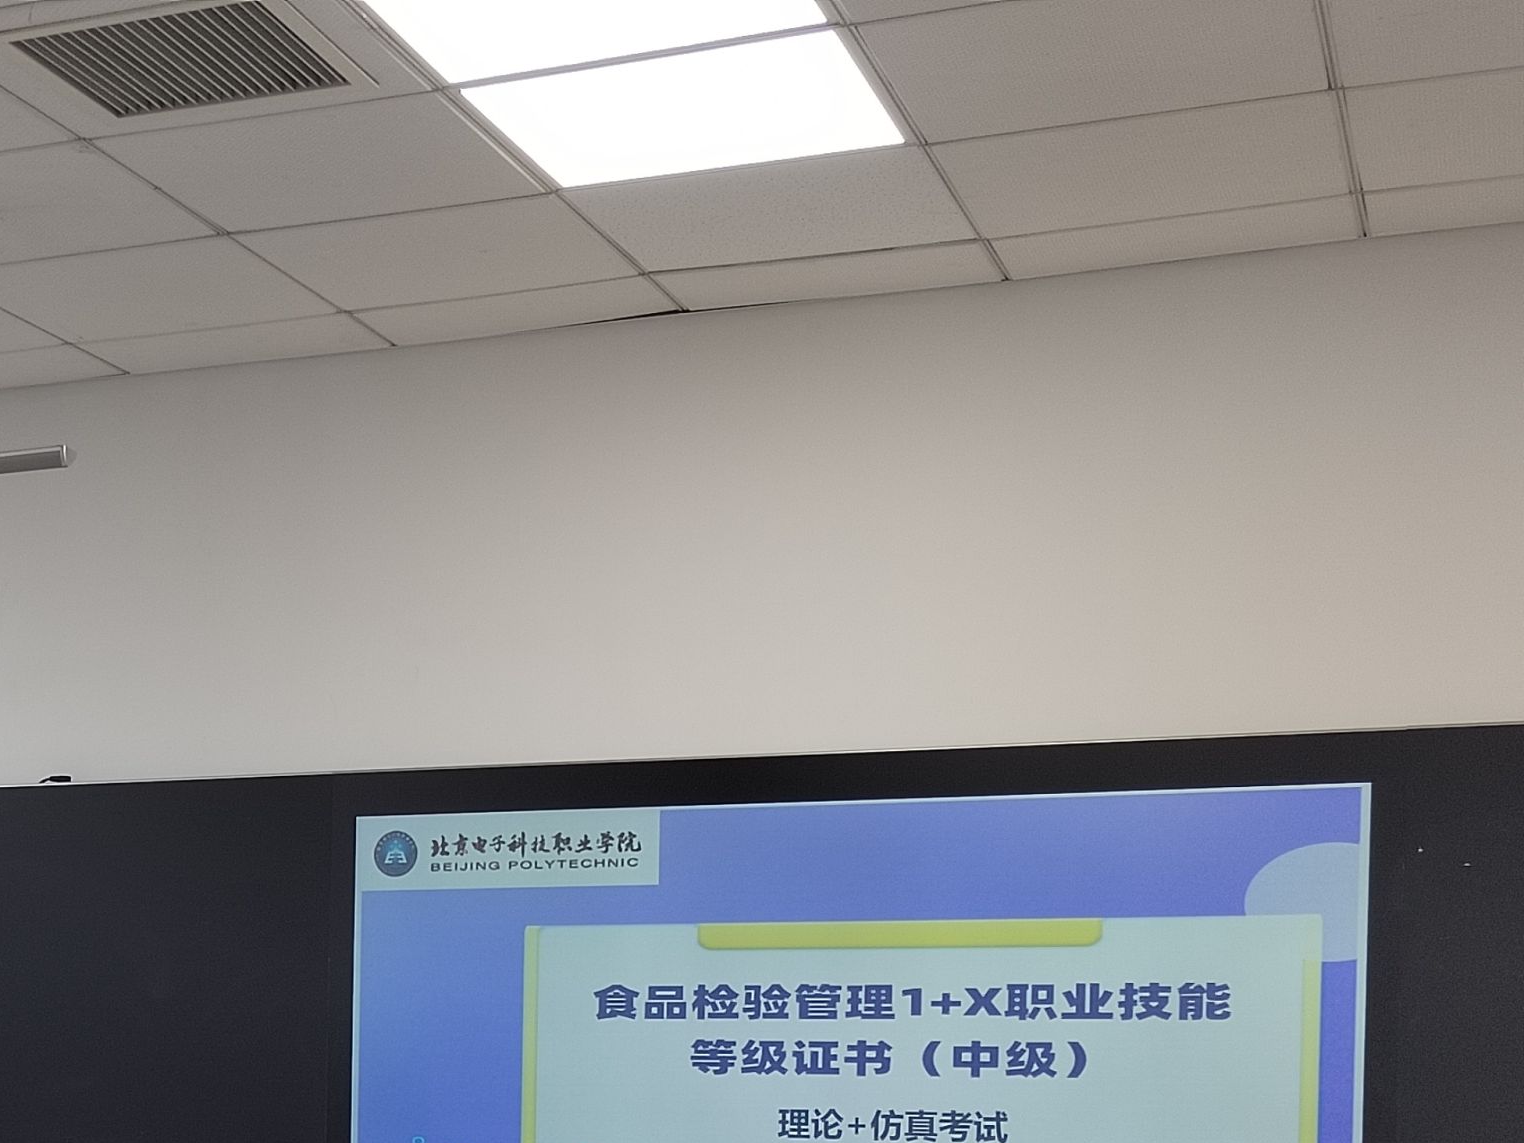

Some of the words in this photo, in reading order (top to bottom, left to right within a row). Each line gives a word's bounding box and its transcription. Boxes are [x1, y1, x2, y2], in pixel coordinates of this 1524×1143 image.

[431, 831, 641, 858] 北京电子科技职业学院
[430, 860, 500, 872] BEIJING
[508, 857, 640, 870] POLYTECHNIC
[594, 982, 1232, 1021] 食品检验管理1+X职业技能
[690, 1038, 1088, 1078] 等级证书（中级）
[778, 1108, 1009, 1143] 理论+仿真考试
